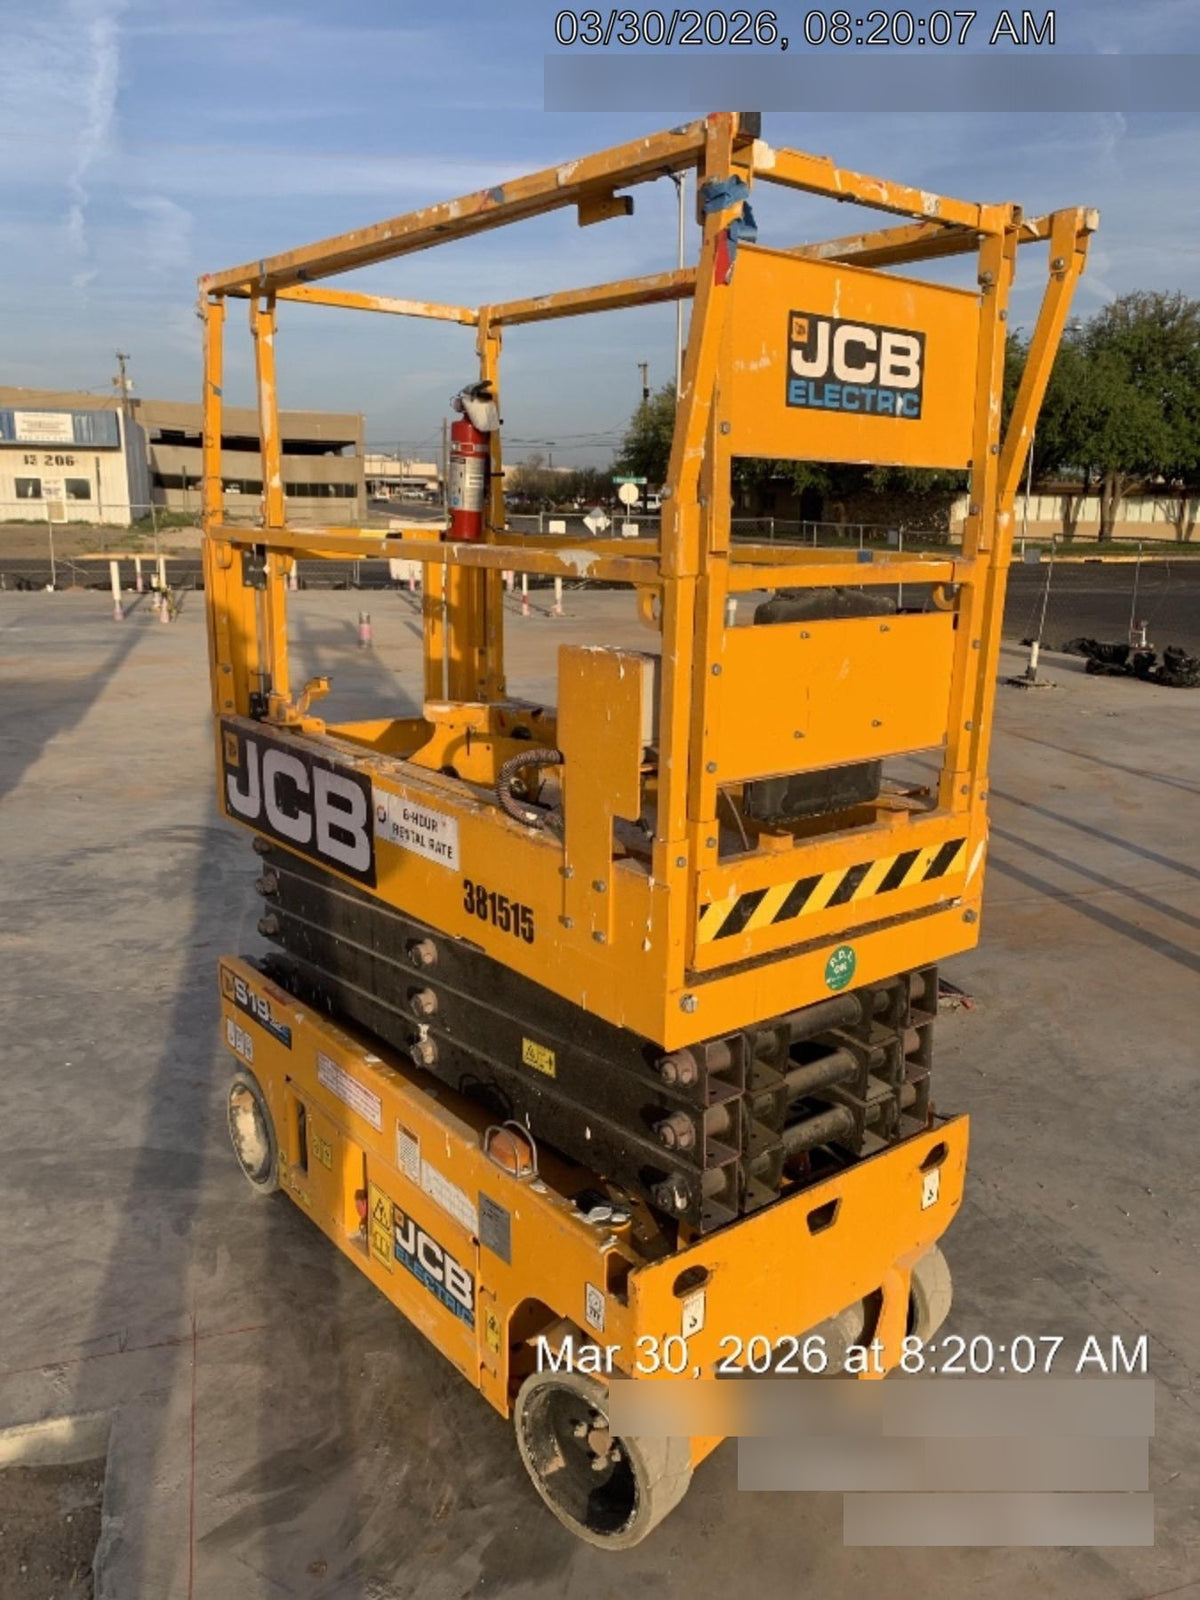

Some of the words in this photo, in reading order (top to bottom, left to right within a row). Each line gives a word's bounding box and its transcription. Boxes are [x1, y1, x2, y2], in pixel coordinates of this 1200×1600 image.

[791, 321, 921, 389] JCB
[788, 379, 919, 416] ELECTRIC
[44, 454, 75, 467] 206
[227, 740, 372, 872] JCB
[463, 879, 535, 945] 381515
[396, 1219, 474, 1310] JCB
